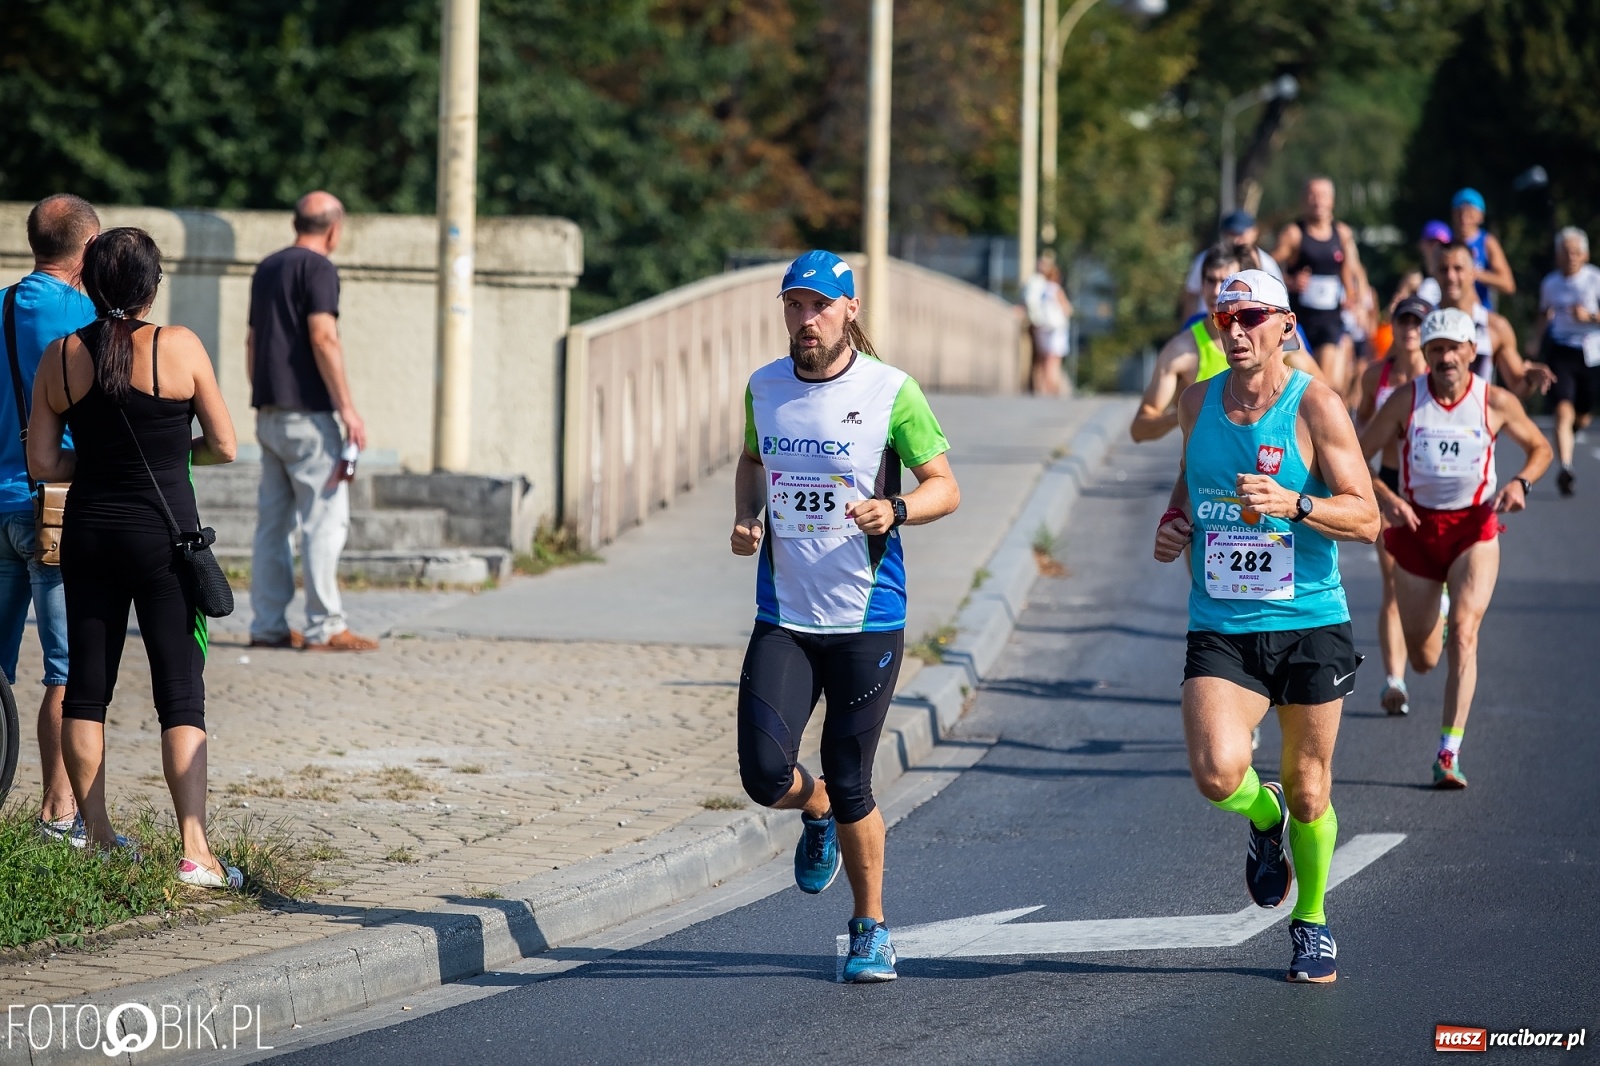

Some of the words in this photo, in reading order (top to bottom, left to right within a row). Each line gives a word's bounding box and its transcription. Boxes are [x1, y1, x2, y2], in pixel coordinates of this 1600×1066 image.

[1439, 441, 1460, 456] 94
[1198, 487, 1240, 497] ENERGETYK
[794, 491, 836, 512] 235
[1206, 524, 1277, 532] www.ensoll
[1230, 550, 1272, 572] 282
